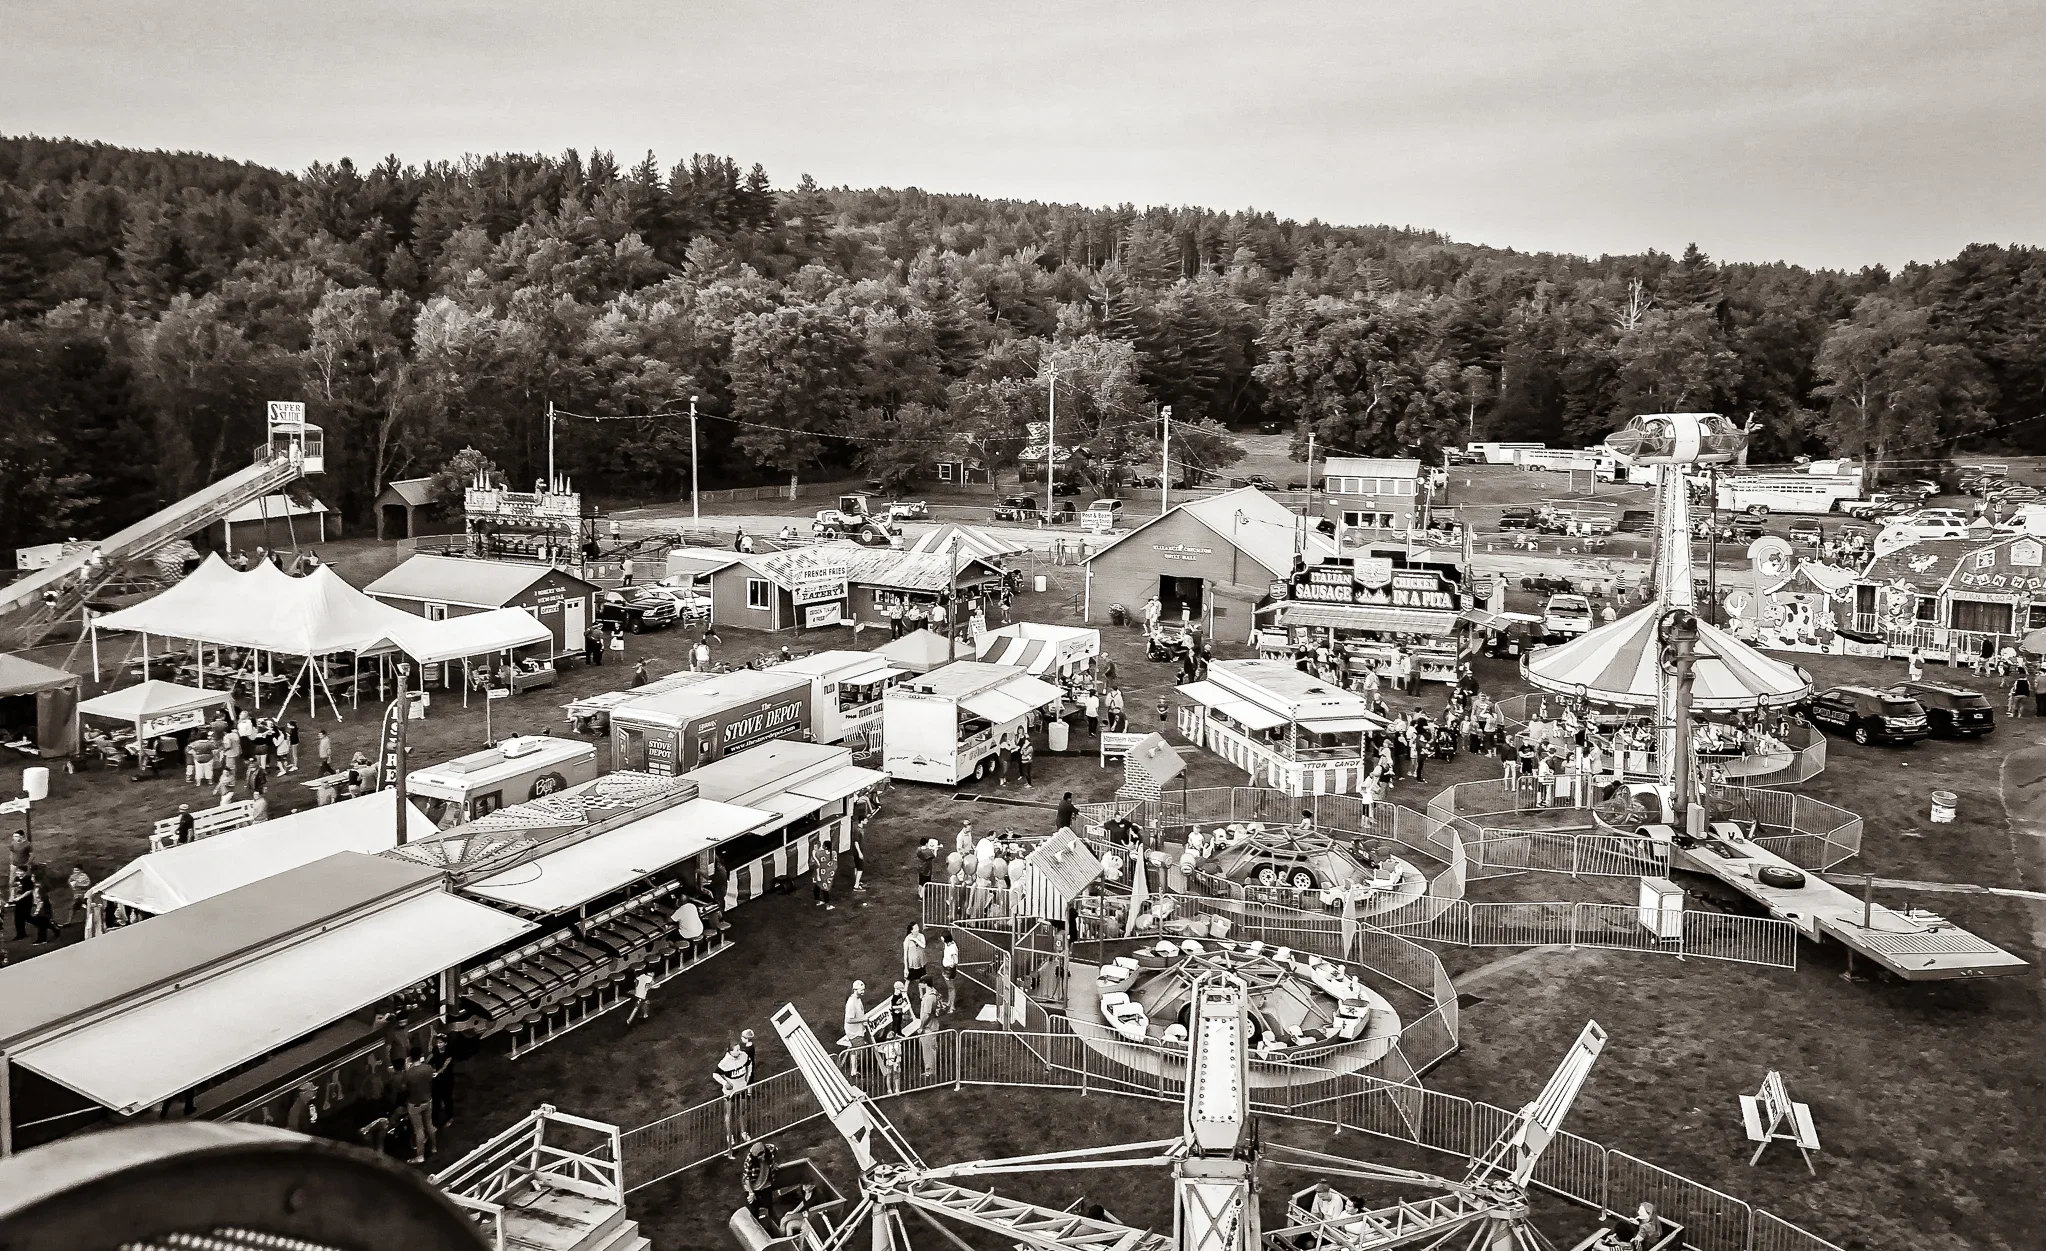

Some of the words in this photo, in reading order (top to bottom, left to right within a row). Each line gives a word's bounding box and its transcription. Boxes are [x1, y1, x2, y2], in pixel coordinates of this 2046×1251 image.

[804, 568, 827, 579] FRENCH
[828, 567, 846, 576] FRIES
[1310, 571, 1353, 585] ITALIAN
[1392, 576, 1438, 591] CHICKEN
[802, 588, 838, 601] EATERY
[1295, 583, 1353, 602] SAUSAGE
[1392, 589, 1410, 605] IN
[1409, 590, 1423, 606] A
[1421, 591, 1454, 609] PITA
[761, 702, 772, 712] The
[1812, 706, 1850, 722] POLICE
[723, 712, 764, 743] STOVE
[765, 701, 803, 729] DEPOT
[648, 739, 673, 751] STOVE
[730, 725, 796, 753] www.thestovedepot.com
[648, 748, 673, 759] DEPOT
[1302, 762, 1328, 770] TTON
[1334, 759, 1361, 768] CANDY
